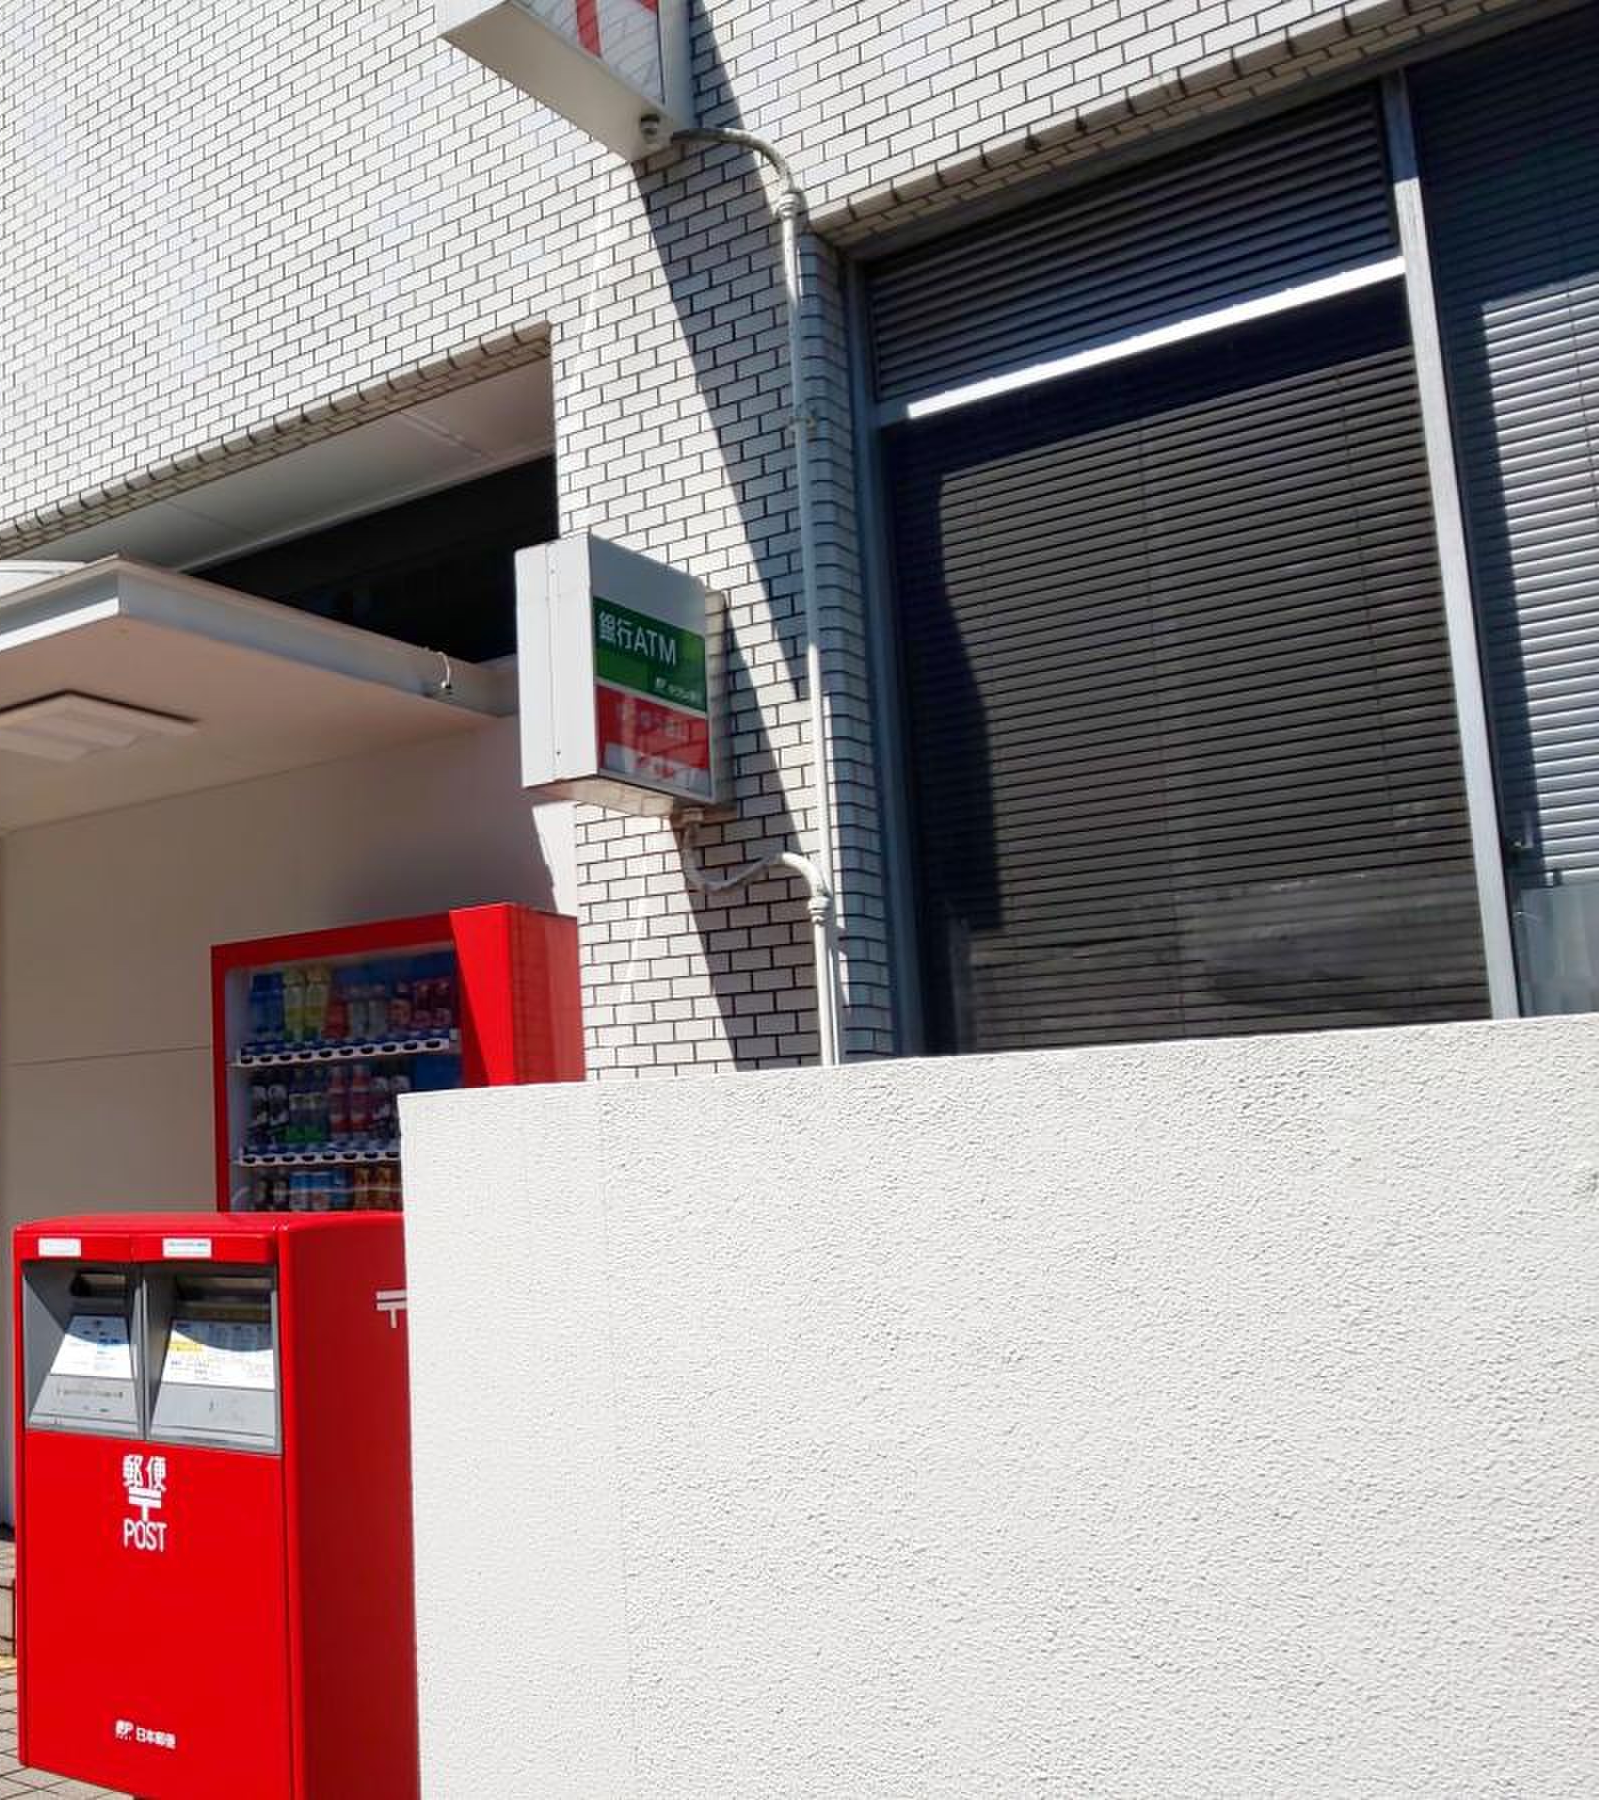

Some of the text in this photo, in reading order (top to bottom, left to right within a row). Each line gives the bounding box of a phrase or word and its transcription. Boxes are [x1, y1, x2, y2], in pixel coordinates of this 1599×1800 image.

[599, 610, 677, 666] 銀行ATM
[122, 1454, 167, 1492] 郵便
[123, 1517, 168, 1553] POST
